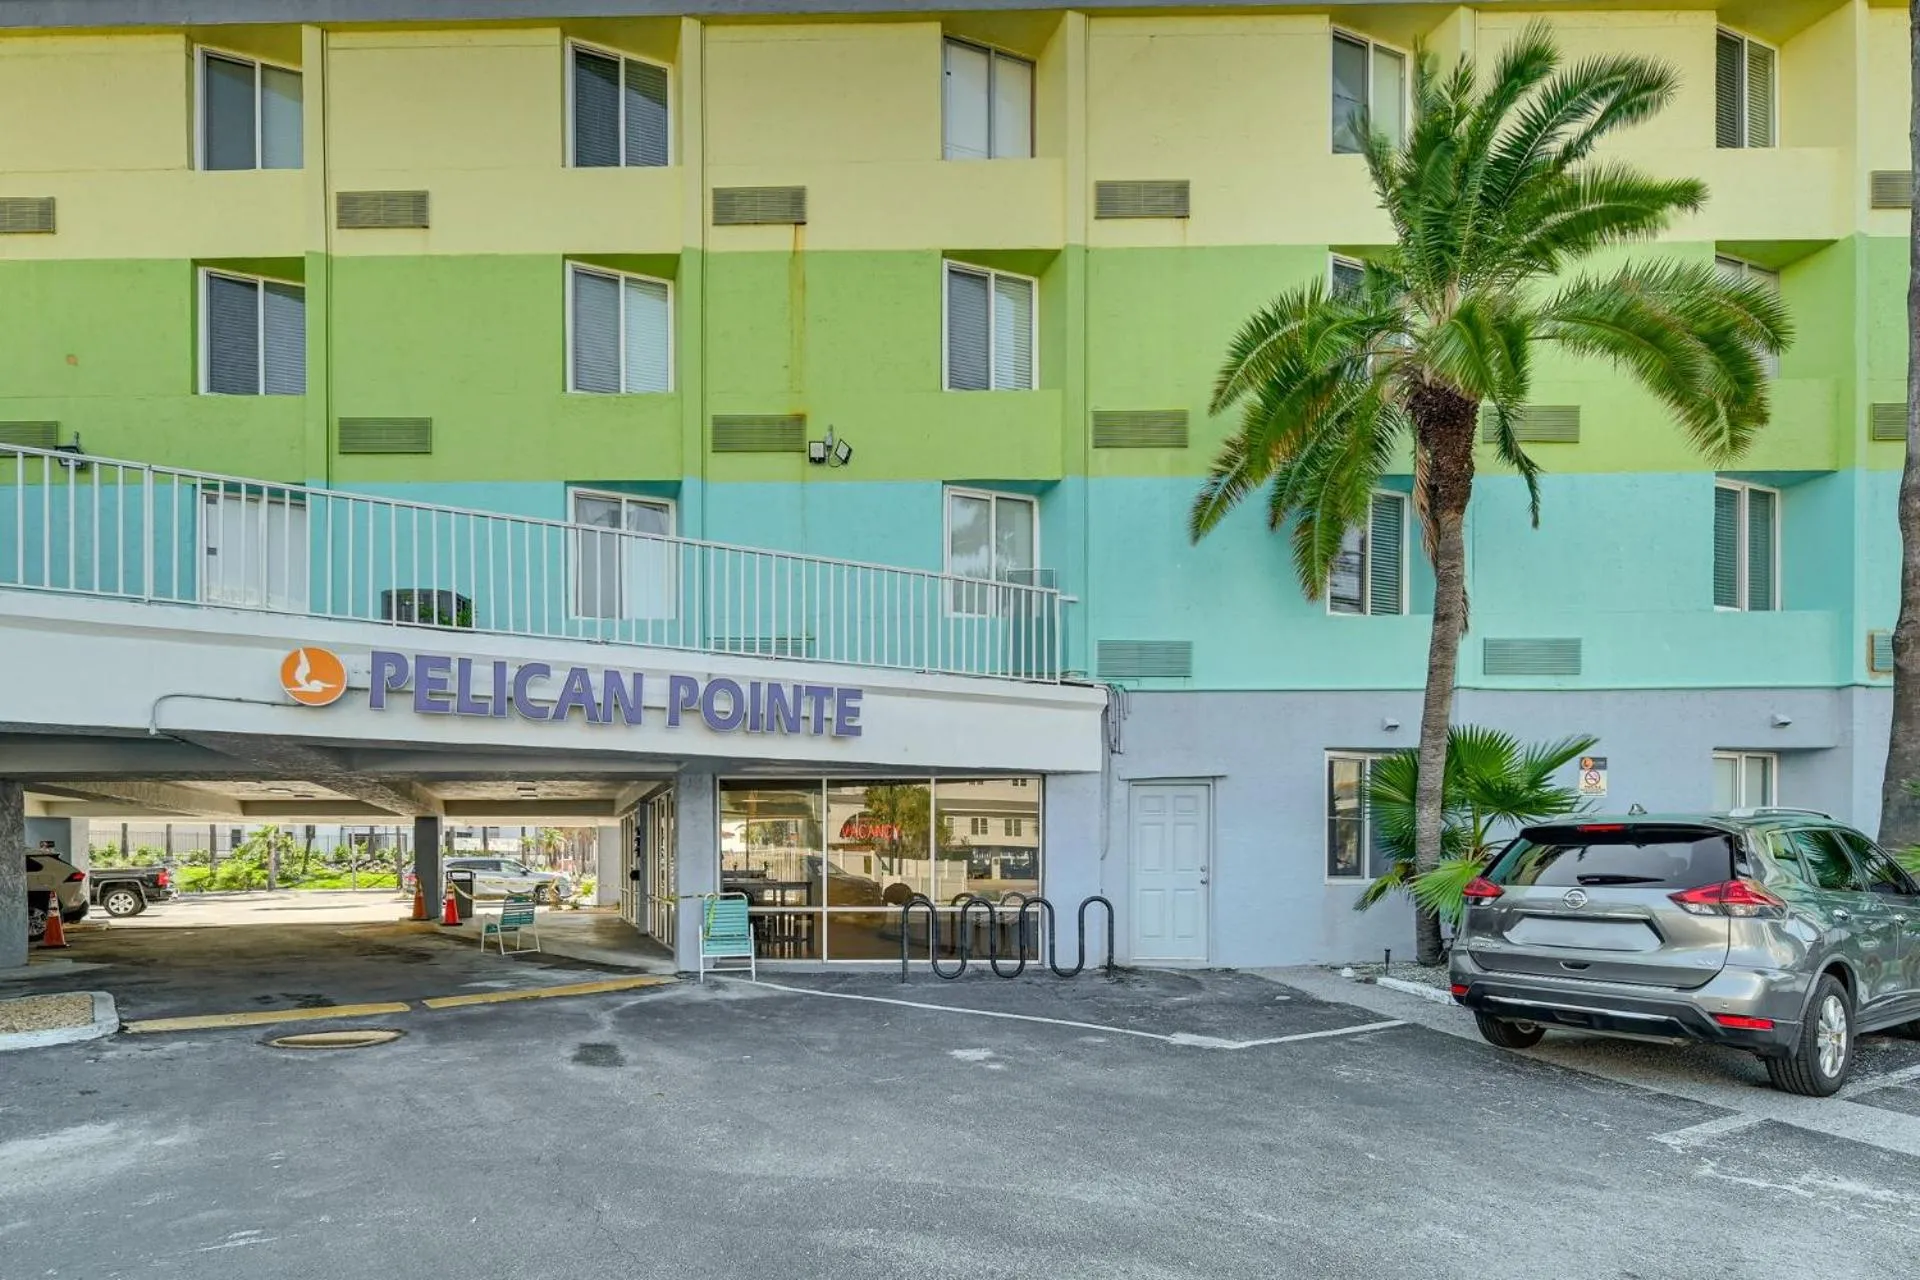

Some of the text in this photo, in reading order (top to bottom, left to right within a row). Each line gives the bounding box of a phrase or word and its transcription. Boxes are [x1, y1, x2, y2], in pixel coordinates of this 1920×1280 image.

[369, 651, 863, 737] PELICAN POINTE
[841, 823, 902, 840] VACANCY
